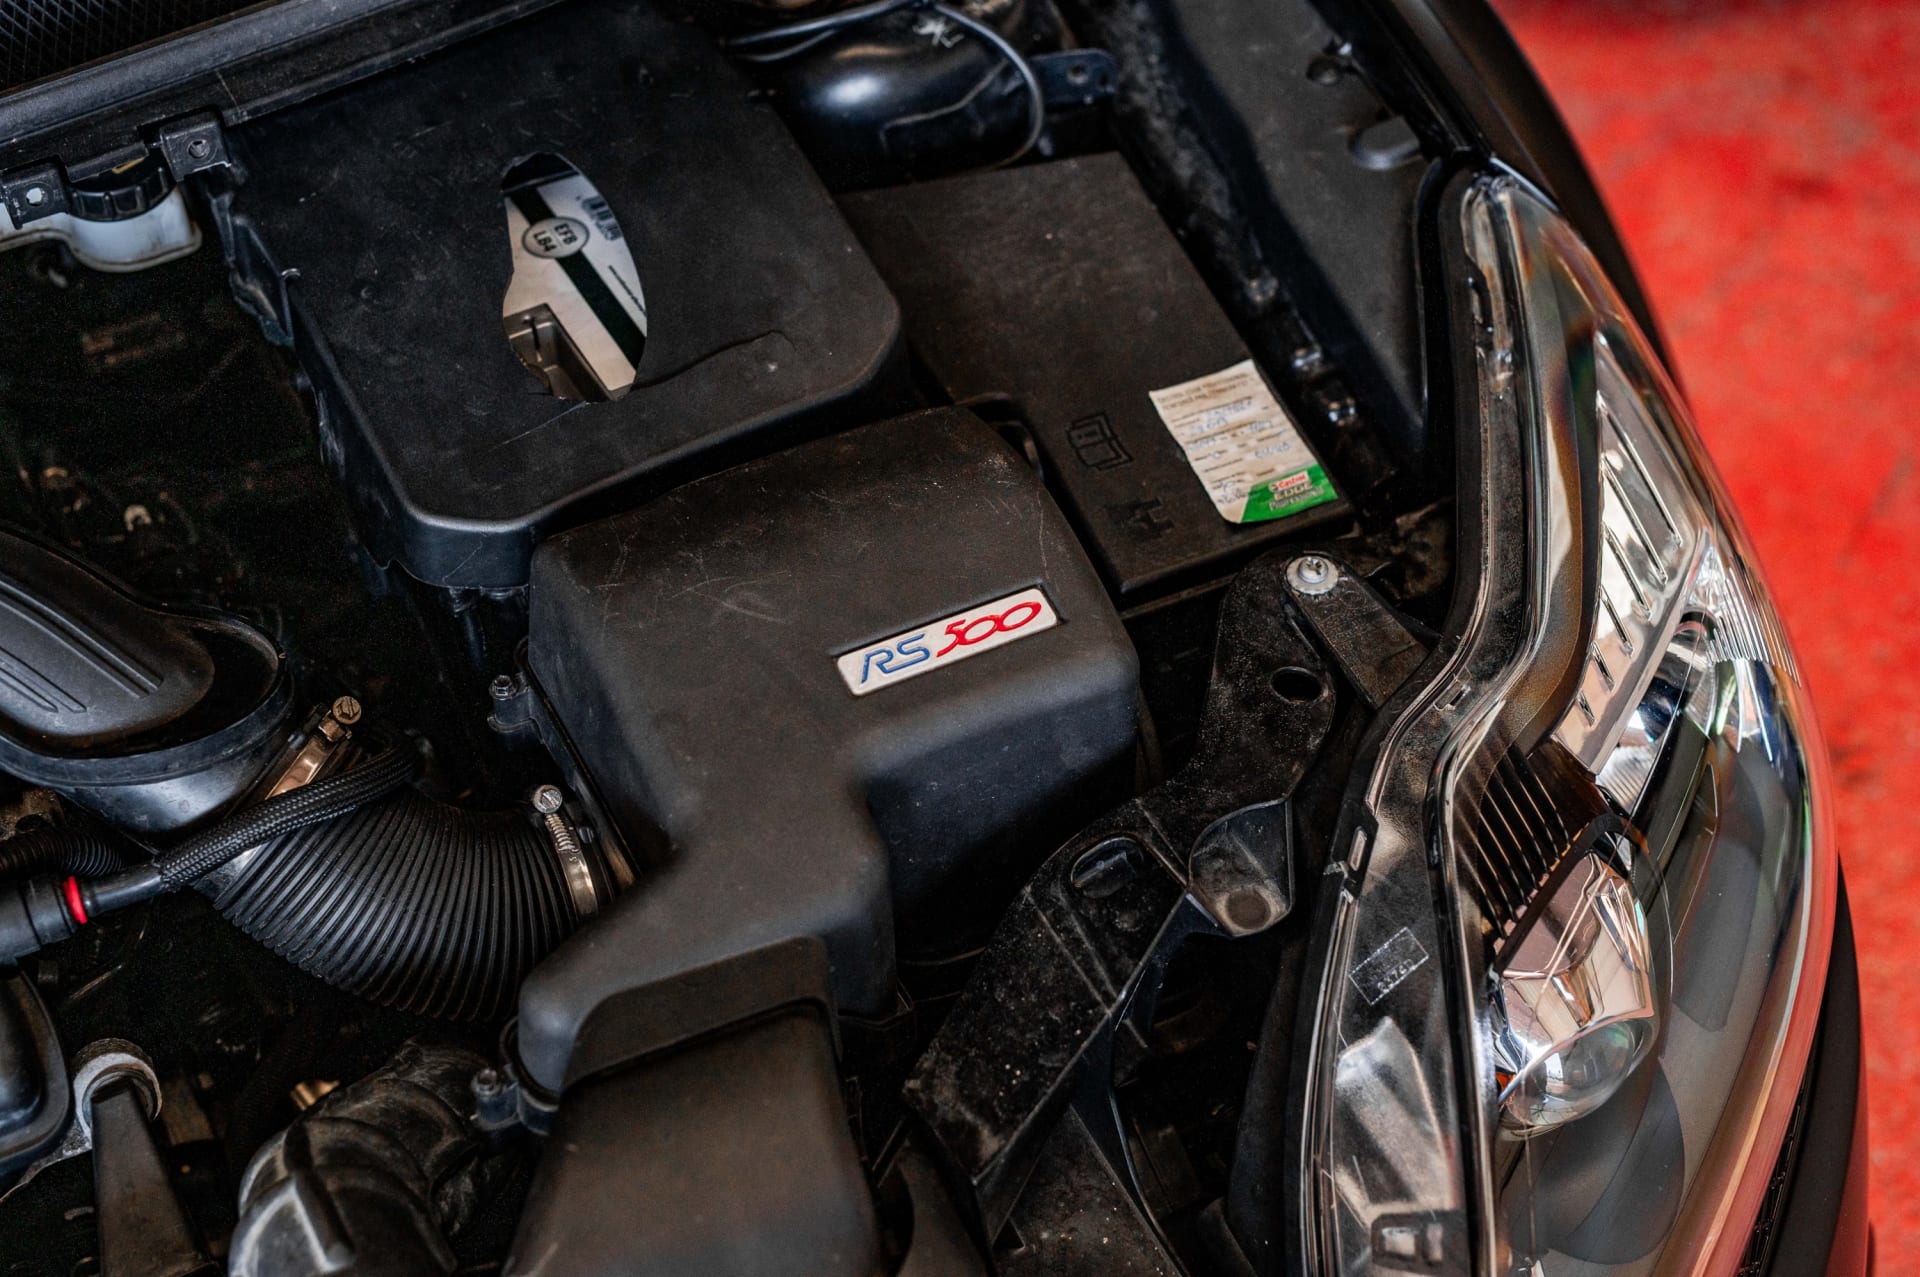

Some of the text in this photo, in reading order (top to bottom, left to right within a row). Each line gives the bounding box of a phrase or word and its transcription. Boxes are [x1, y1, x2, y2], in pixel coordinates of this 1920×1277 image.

[554, 223, 578, 245] EFB
[1277, 473, 1308, 490] Castrol
[860, 601, 1042, 684] RS 500
